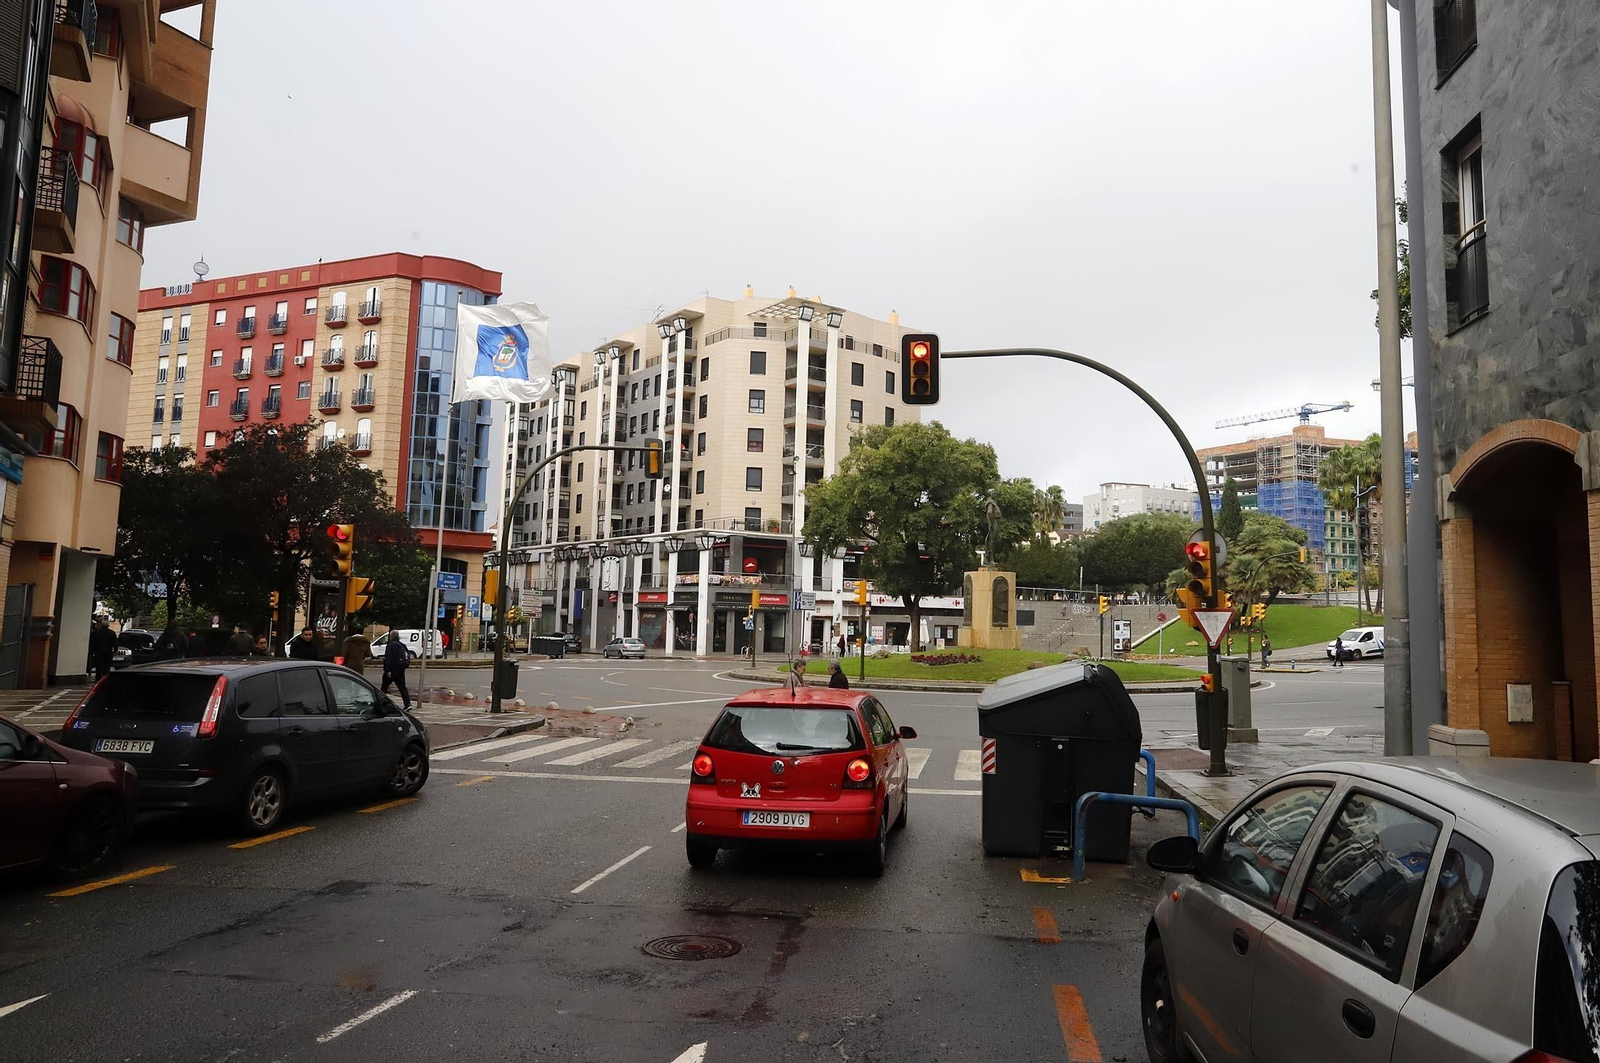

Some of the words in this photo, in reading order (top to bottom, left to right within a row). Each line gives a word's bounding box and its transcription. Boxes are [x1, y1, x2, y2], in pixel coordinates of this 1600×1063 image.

[469, 597, 477, 608] P
[103, 740, 128, 751] 6838
[131, 741, 151, 752] FVC
[751, 812, 779, 825] 2909
[783, 813, 805, 826] DVG
